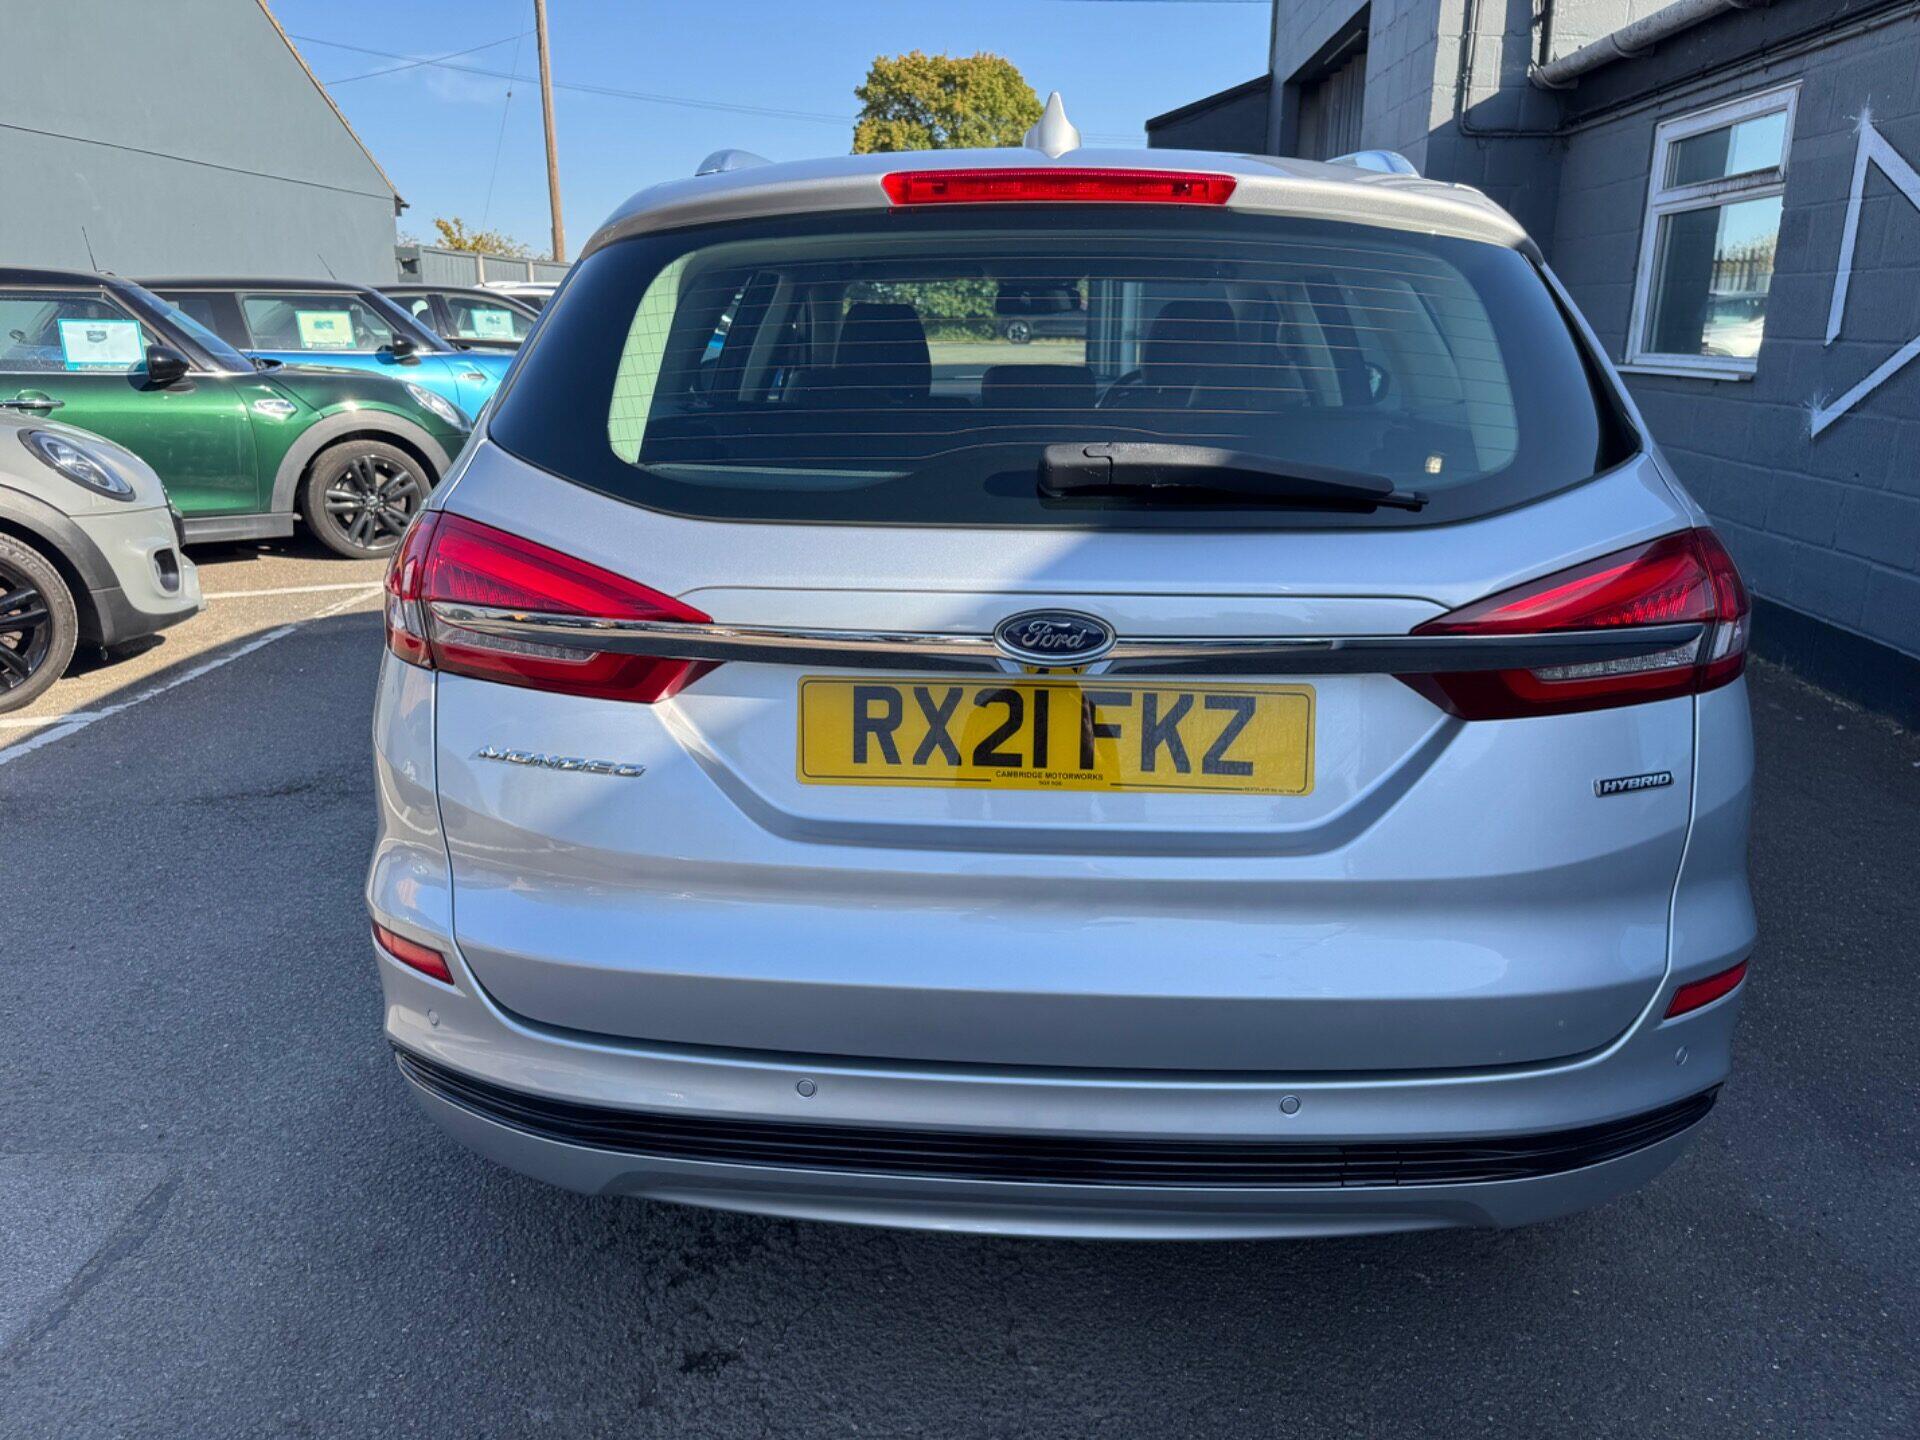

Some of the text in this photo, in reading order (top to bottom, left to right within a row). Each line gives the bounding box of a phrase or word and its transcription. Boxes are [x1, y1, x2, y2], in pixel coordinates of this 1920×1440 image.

[1021, 620, 1087, 648] Ford
[852, 685, 1257, 776] RX21 FKZ
[470, 744, 646, 778] MONDEO
[995, 769, 1104, 781] CAMBRIDGE MOTORWORKS
[1602, 772, 1671, 793] HYBRID
